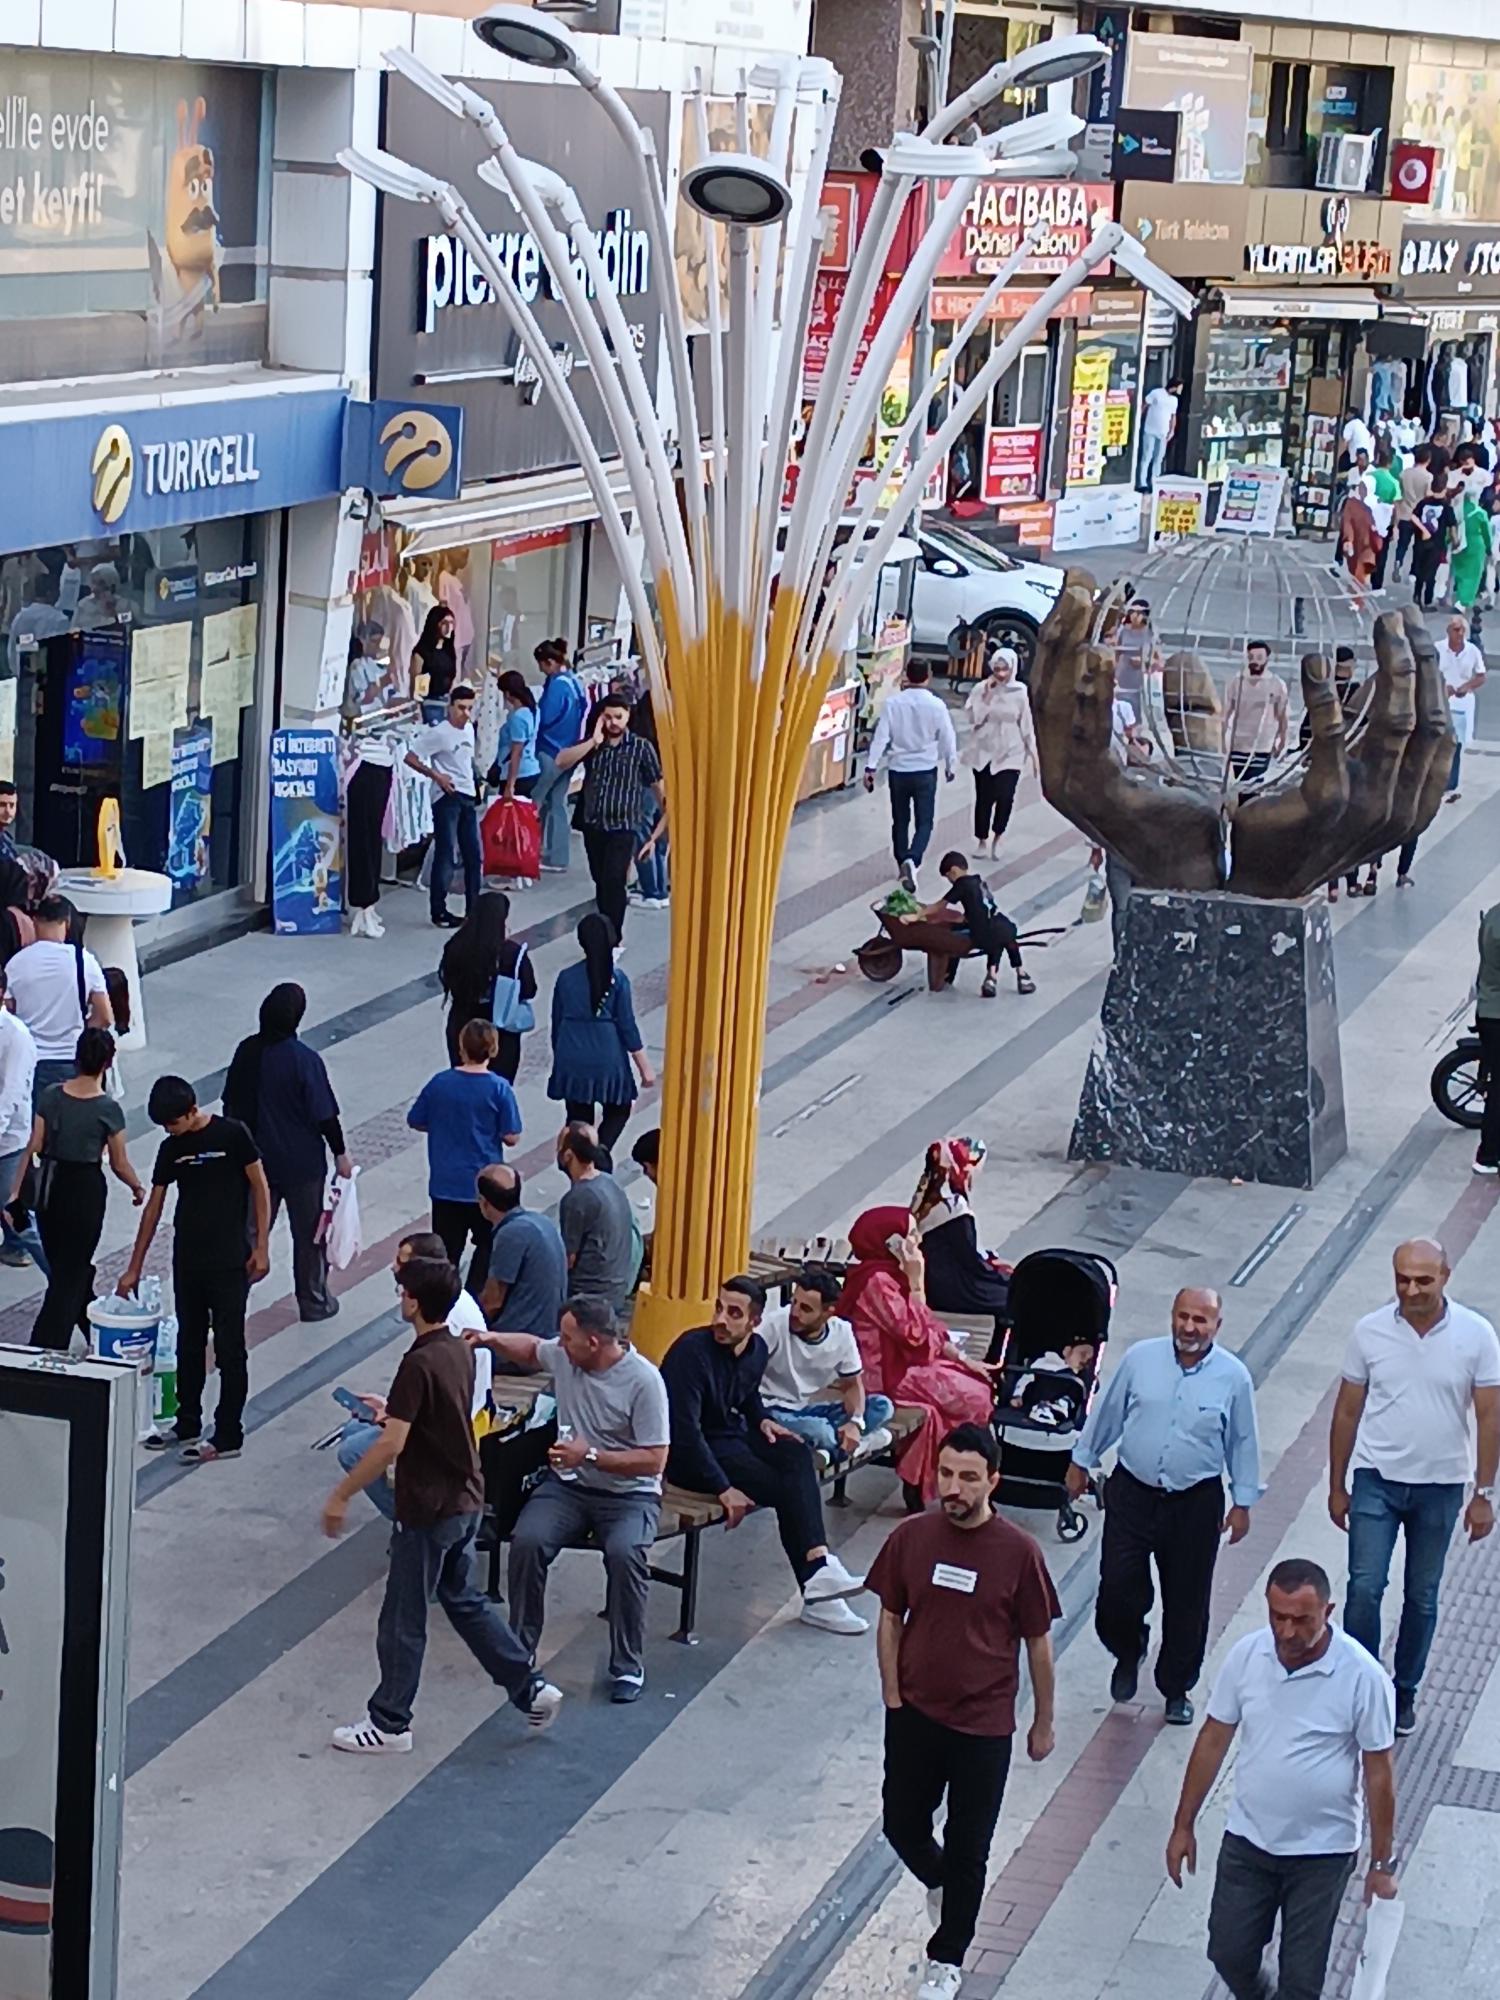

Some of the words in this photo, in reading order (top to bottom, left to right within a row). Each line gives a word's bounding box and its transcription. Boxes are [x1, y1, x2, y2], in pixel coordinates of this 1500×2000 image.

[51, 99, 109, 152] evde
[32, 170, 103, 236] keyfi!
[960, 185, 1087, 228] HACIBABA
[1154, 218, 1180, 241] Türk
[142, 432, 260, 496] TURKCELL
